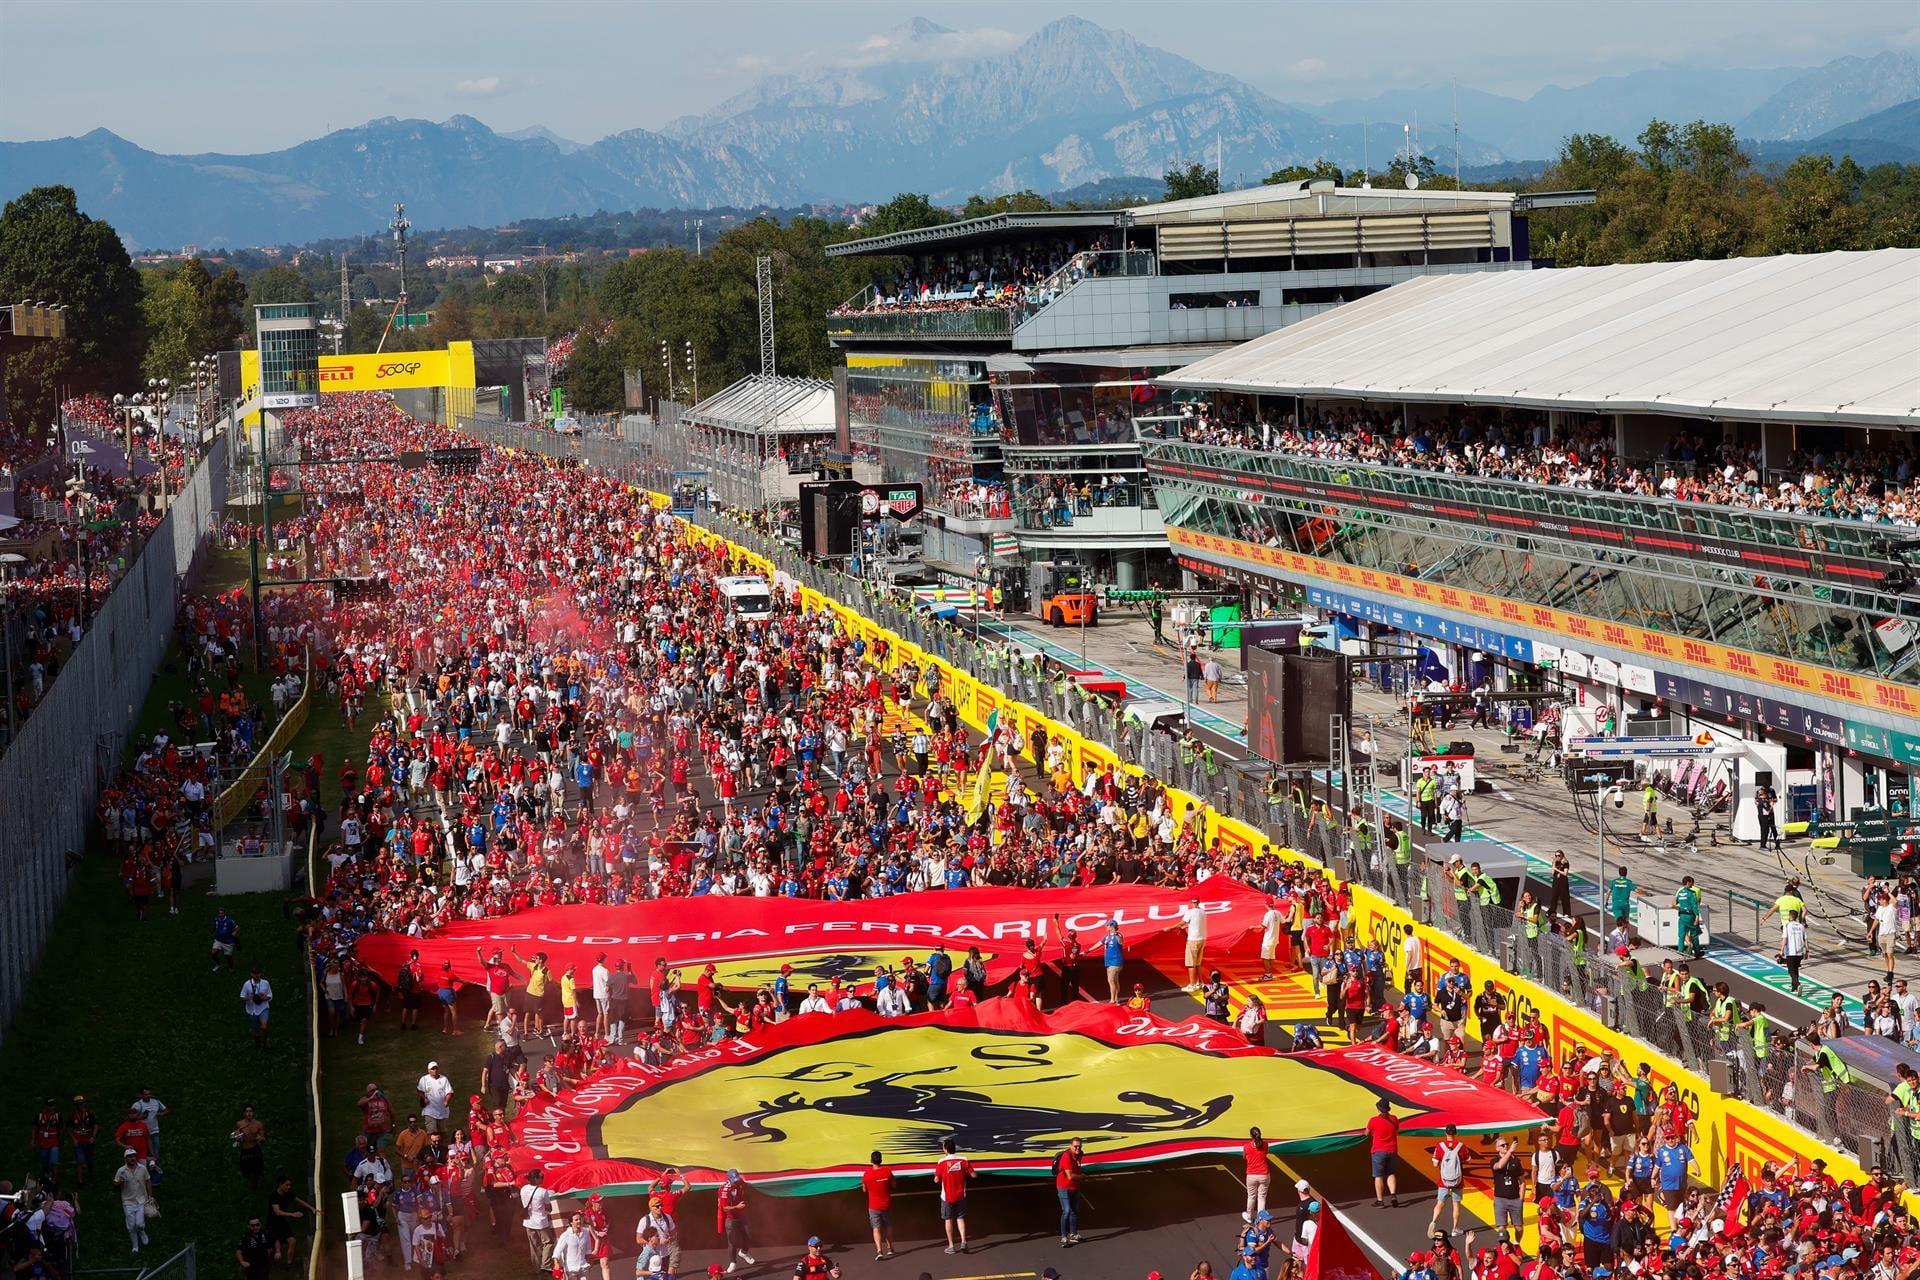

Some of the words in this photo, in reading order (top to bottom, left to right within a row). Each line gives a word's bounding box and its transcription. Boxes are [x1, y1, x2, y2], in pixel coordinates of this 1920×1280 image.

[375, 363, 421, 379] 500GP
[275, 397, 290, 405] 120
[891, 492, 914, 500] TAG
[891, 501, 915, 513] HEUER
[1702, 545, 1725, 556] PADDOCK
[1726, 548, 1741, 558] CLUB
[1533, 608, 1558, 628] DHL
[1567, 616, 1594, 637] DHL
[1602, 624, 1633, 646] DHL
[1642, 632, 1673, 656] DHL
[1683, 641, 1716, 665] DHL
[1726, 651, 1760, 676] DHL
[1772, 662, 1810, 687] DHL
[1821, 673, 1862, 699] DHL
[1875, 684, 1918, 712] DHL
[1813, 727, 1840, 741] COLAPINTO
[1860, 739, 1880, 750] STROLL
[785, 917, 1048, 939] FERRARI
[1066, 900, 1233, 932] CLUB
[571, 1075, 646, 1105] Club
